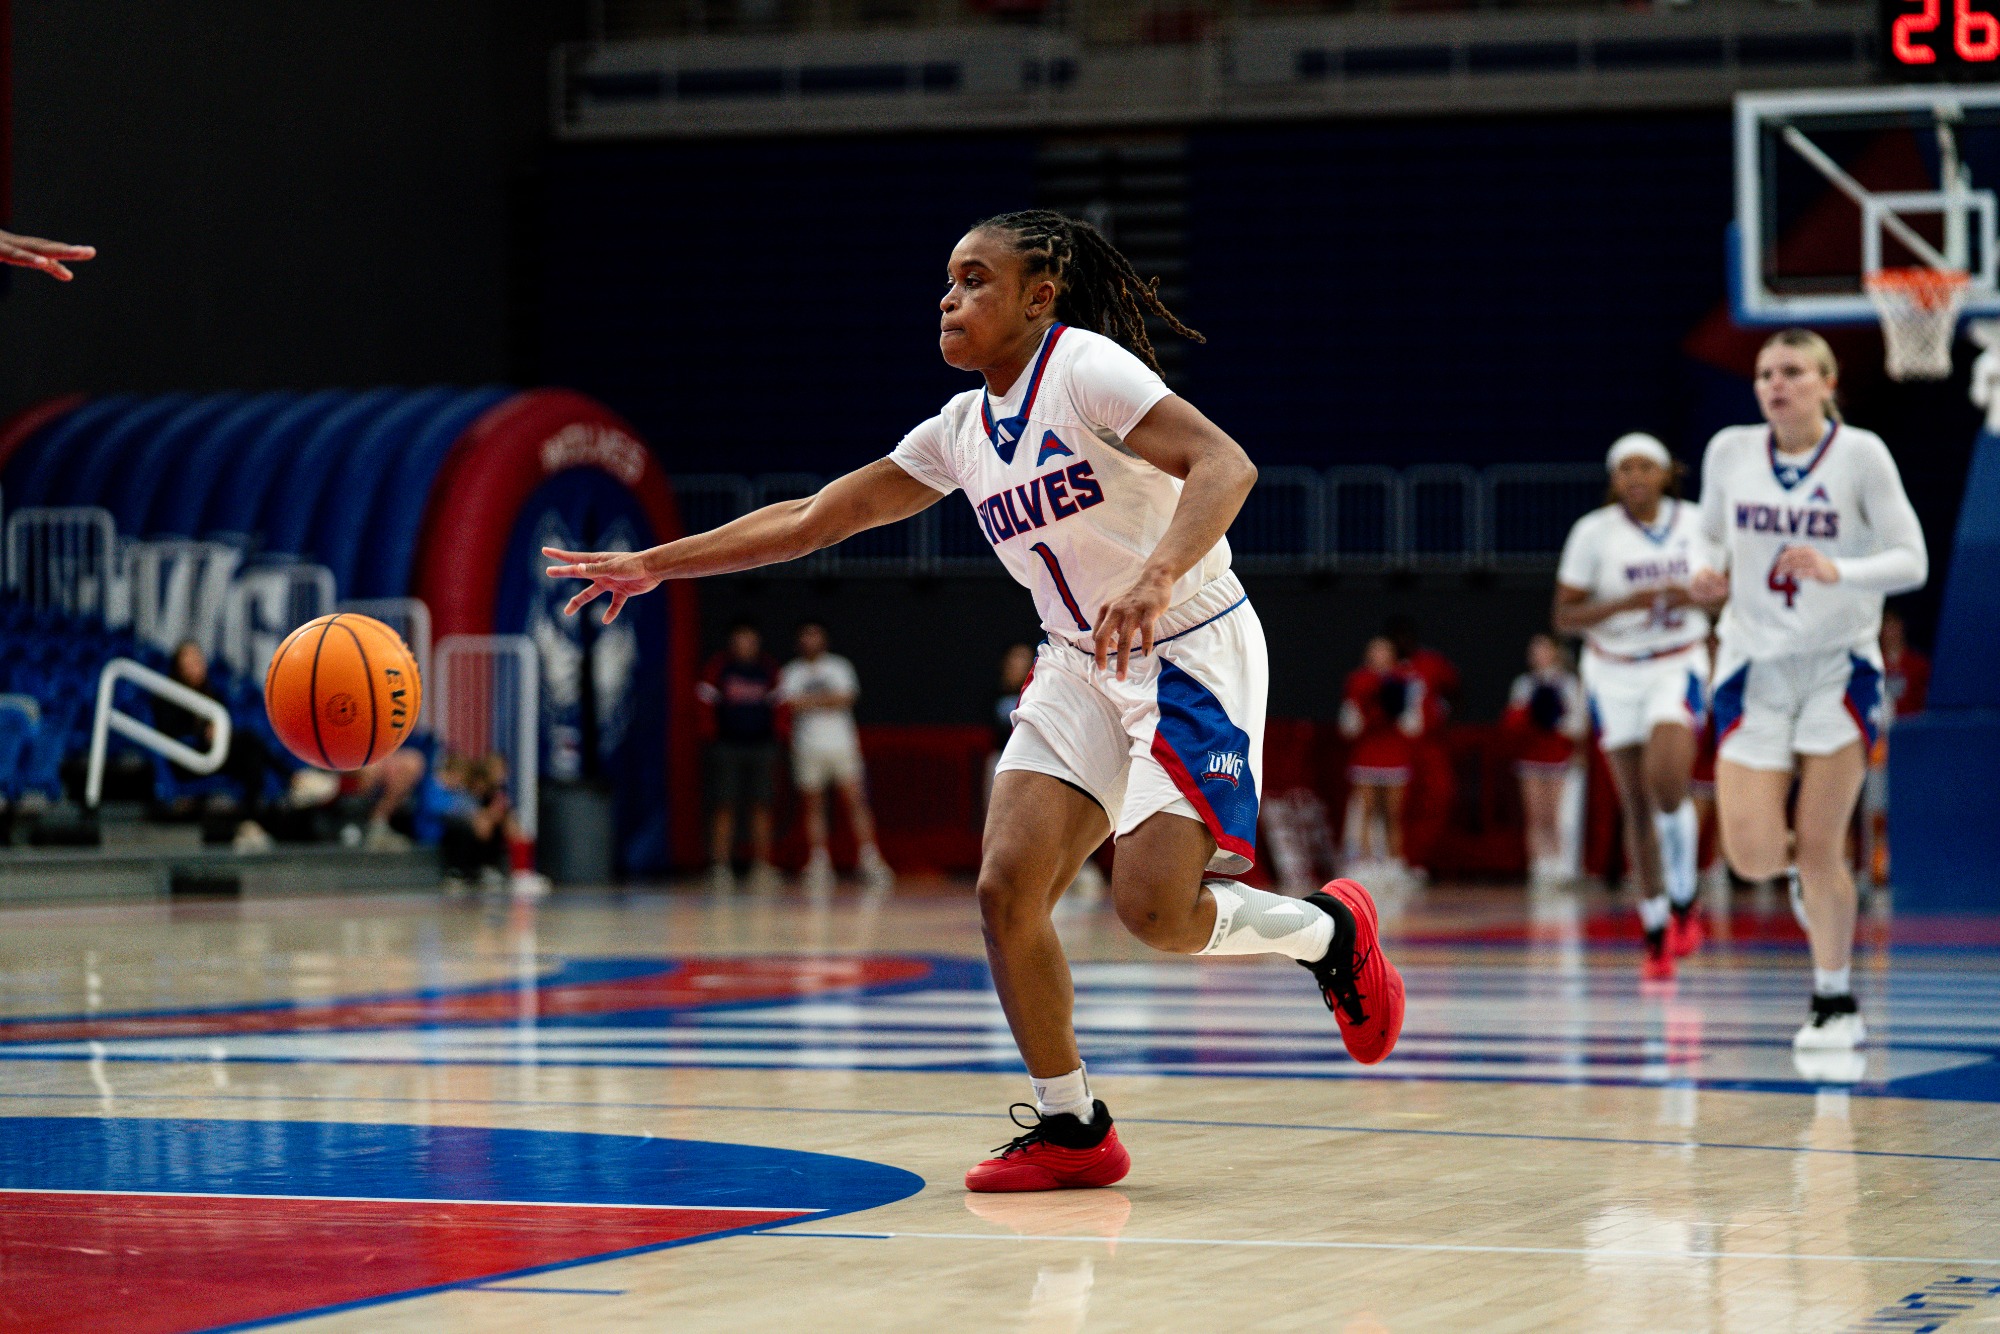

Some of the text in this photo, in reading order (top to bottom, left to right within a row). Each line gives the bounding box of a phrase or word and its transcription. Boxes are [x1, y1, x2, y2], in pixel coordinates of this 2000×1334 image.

[1892, 0, 2000, 64] 26
[976, 459, 1105, 546] WOLVES
[1736, 504, 1839, 538] WOLVES
[1029, 541, 1092, 631] 1
[1209, 752, 1244, 781] UWG
